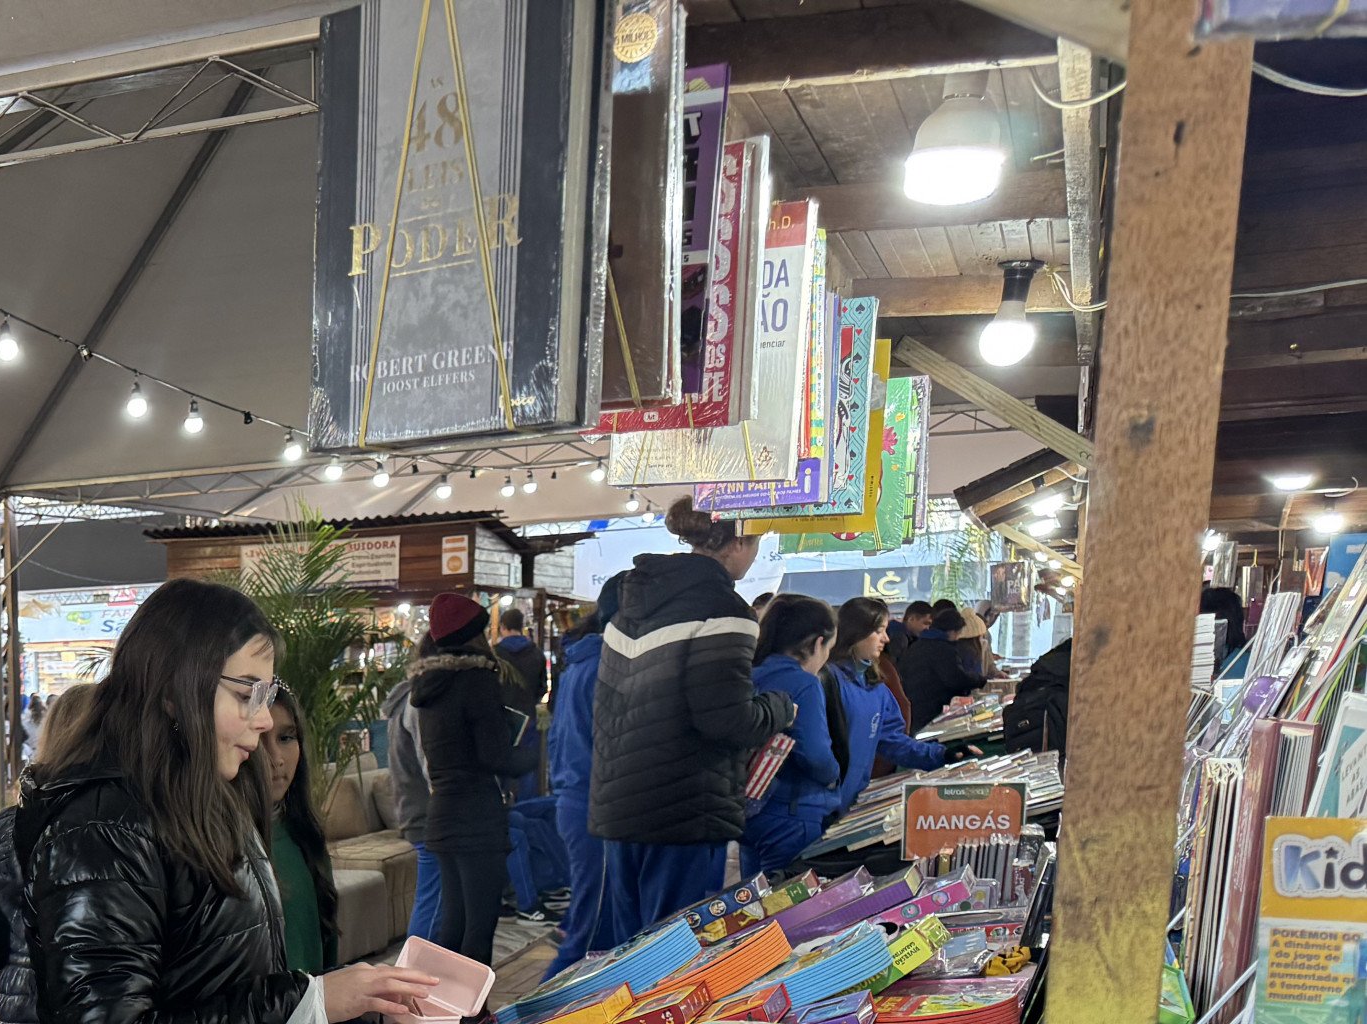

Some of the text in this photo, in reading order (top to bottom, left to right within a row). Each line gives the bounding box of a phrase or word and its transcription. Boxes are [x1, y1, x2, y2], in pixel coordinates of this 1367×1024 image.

[348, 192, 522, 277] PODER
[433, 341, 514, 370] GREENE
[383, 369, 476, 396] JOOST ELFFERS
[916, 810, 1010, 830] MANGÁS
[1272, 928, 1338, 941] POKÉMON
[1284, 940, 1341, 951] dinâmica
[895, 947, 920, 965] DIVERSÃO
[1275, 951, 1340, 962] do jogo de
[1270, 961, 1328, 971] realidade
[1269, 972, 1339, 983] aumentada
[1281, 982, 1342, 993] fenômeno
